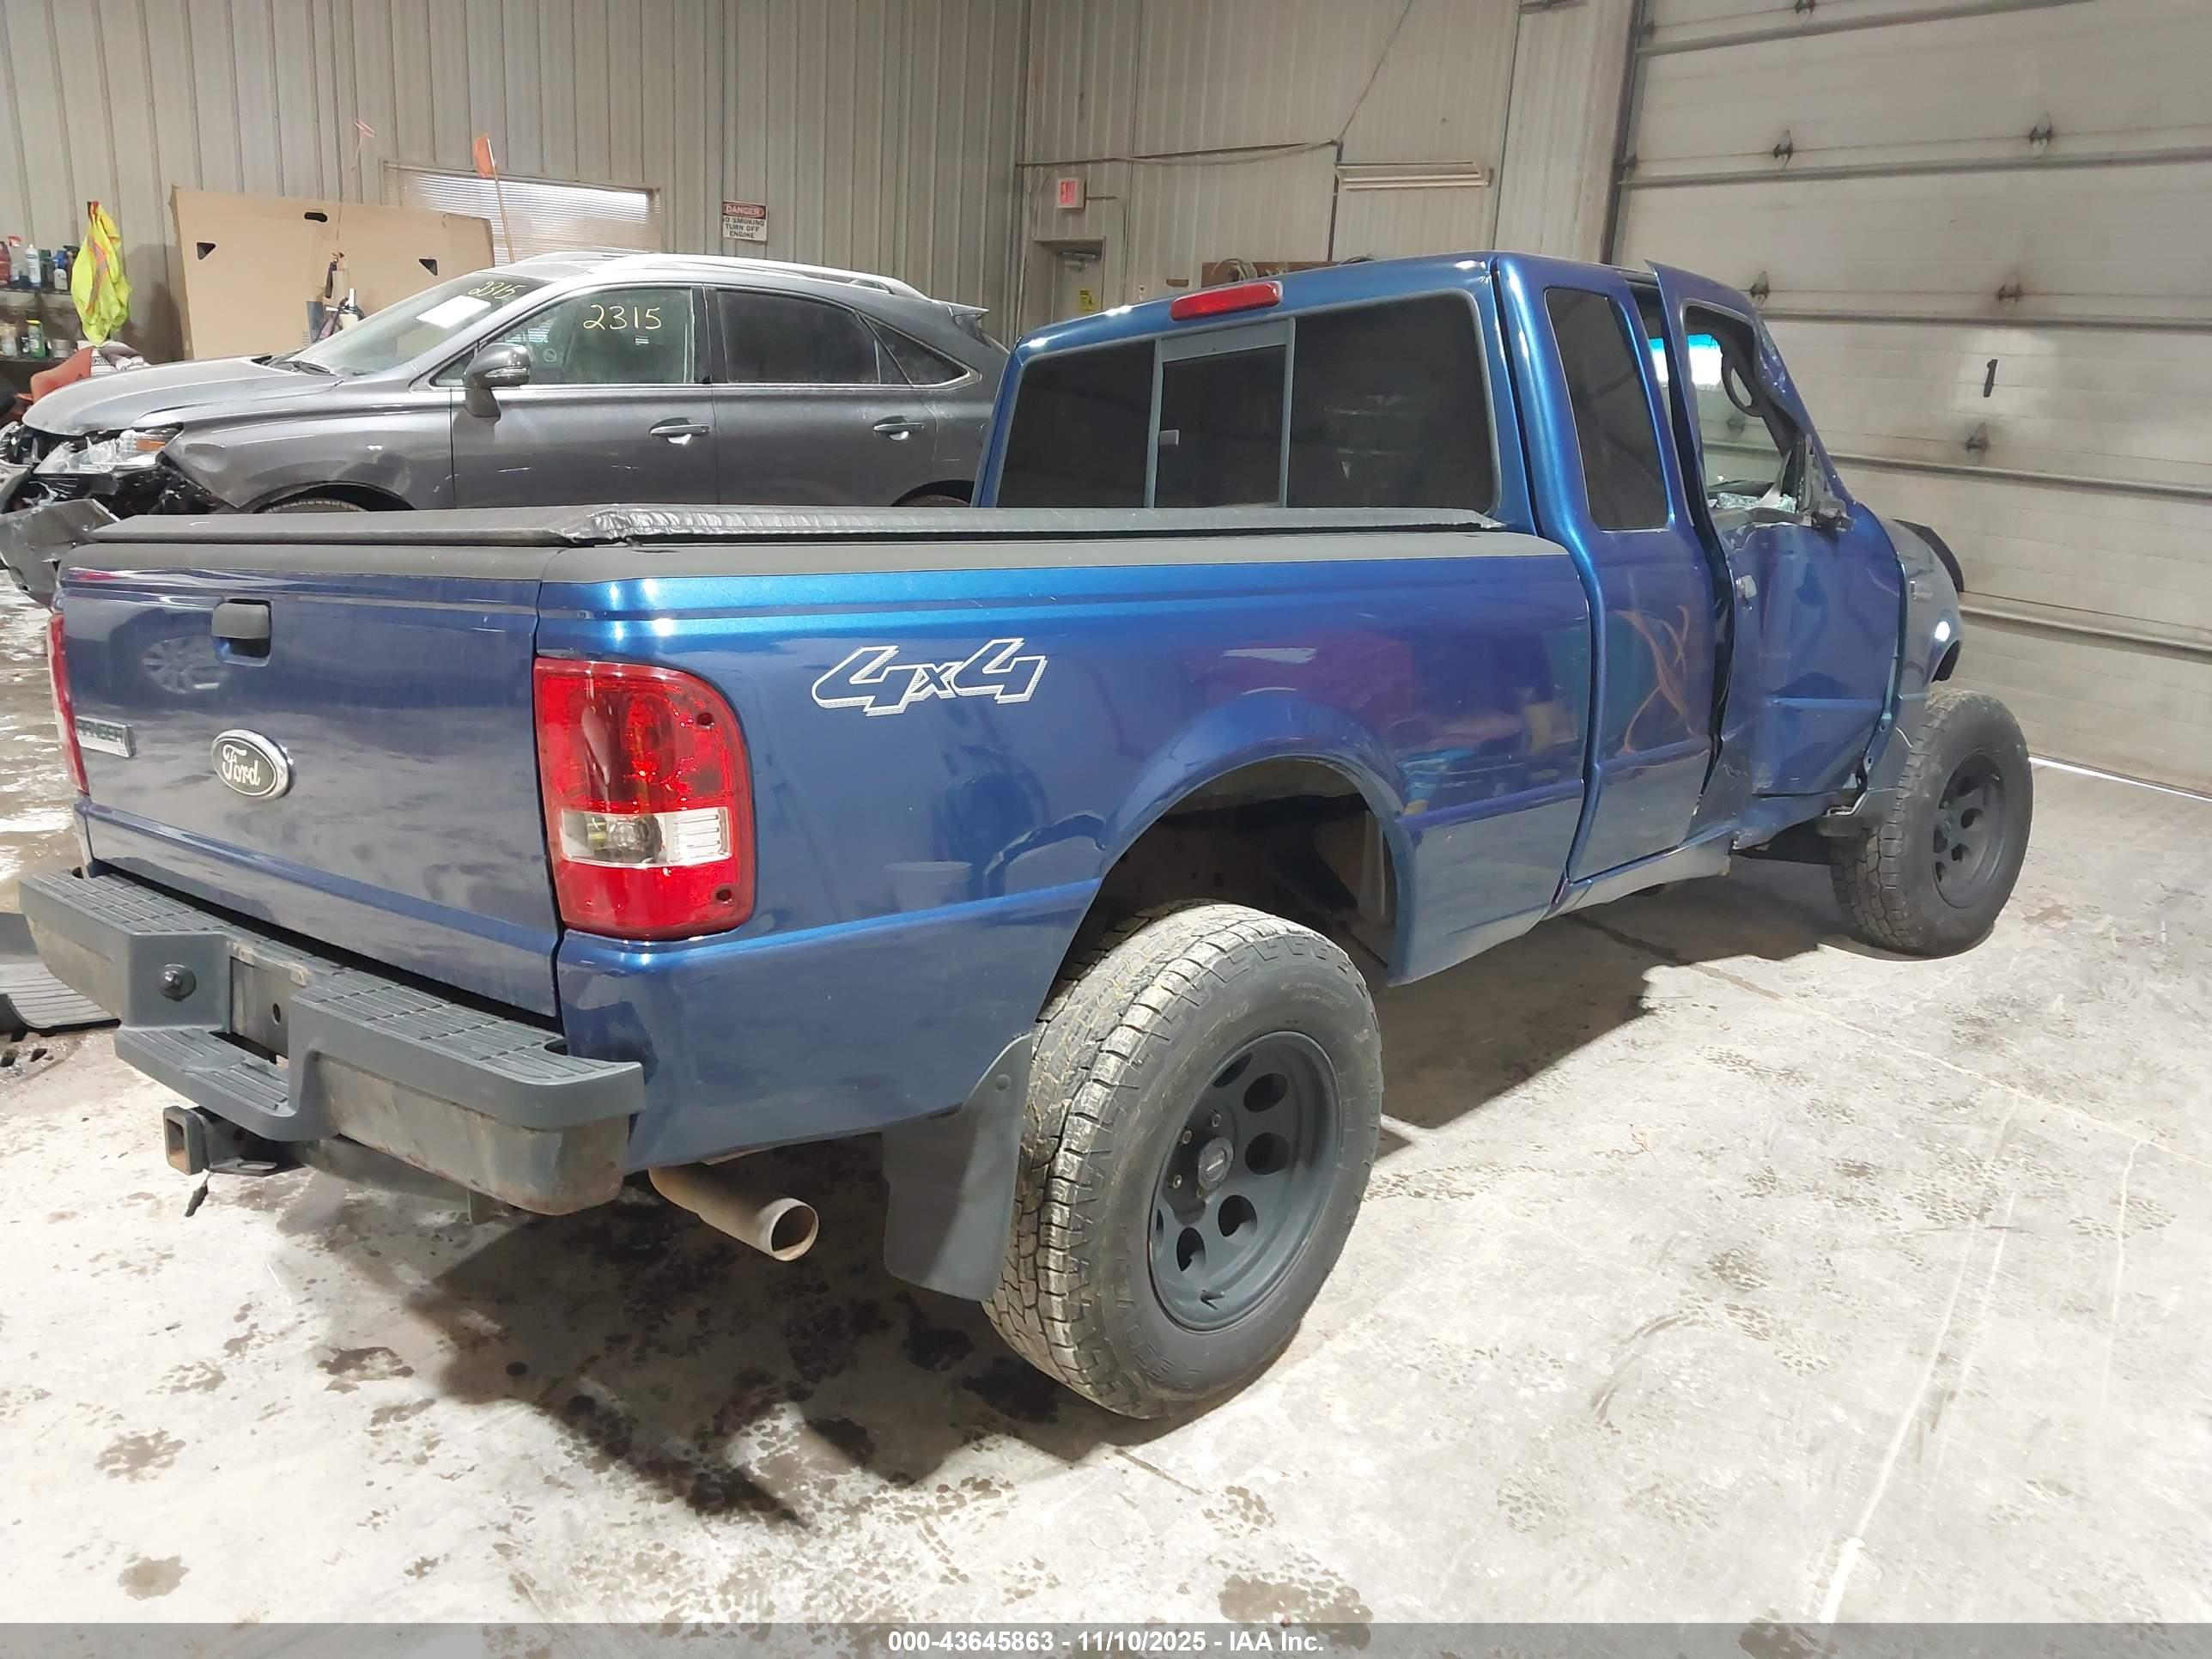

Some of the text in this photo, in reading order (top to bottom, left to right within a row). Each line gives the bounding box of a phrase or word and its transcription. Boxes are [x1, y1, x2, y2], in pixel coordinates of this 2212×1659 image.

[726, 205, 761, 215] DANGER
[732, 217, 765, 226] SMOKING
[729, 230, 756, 239] ENGINE
[467, 281, 528, 299] 2315
[583, 304, 661, 331] 2315
[1983, 358, 1998, 398] 1
[811, 637, 1048, 717] 4x4
[222, 744, 261, 787] Ford
